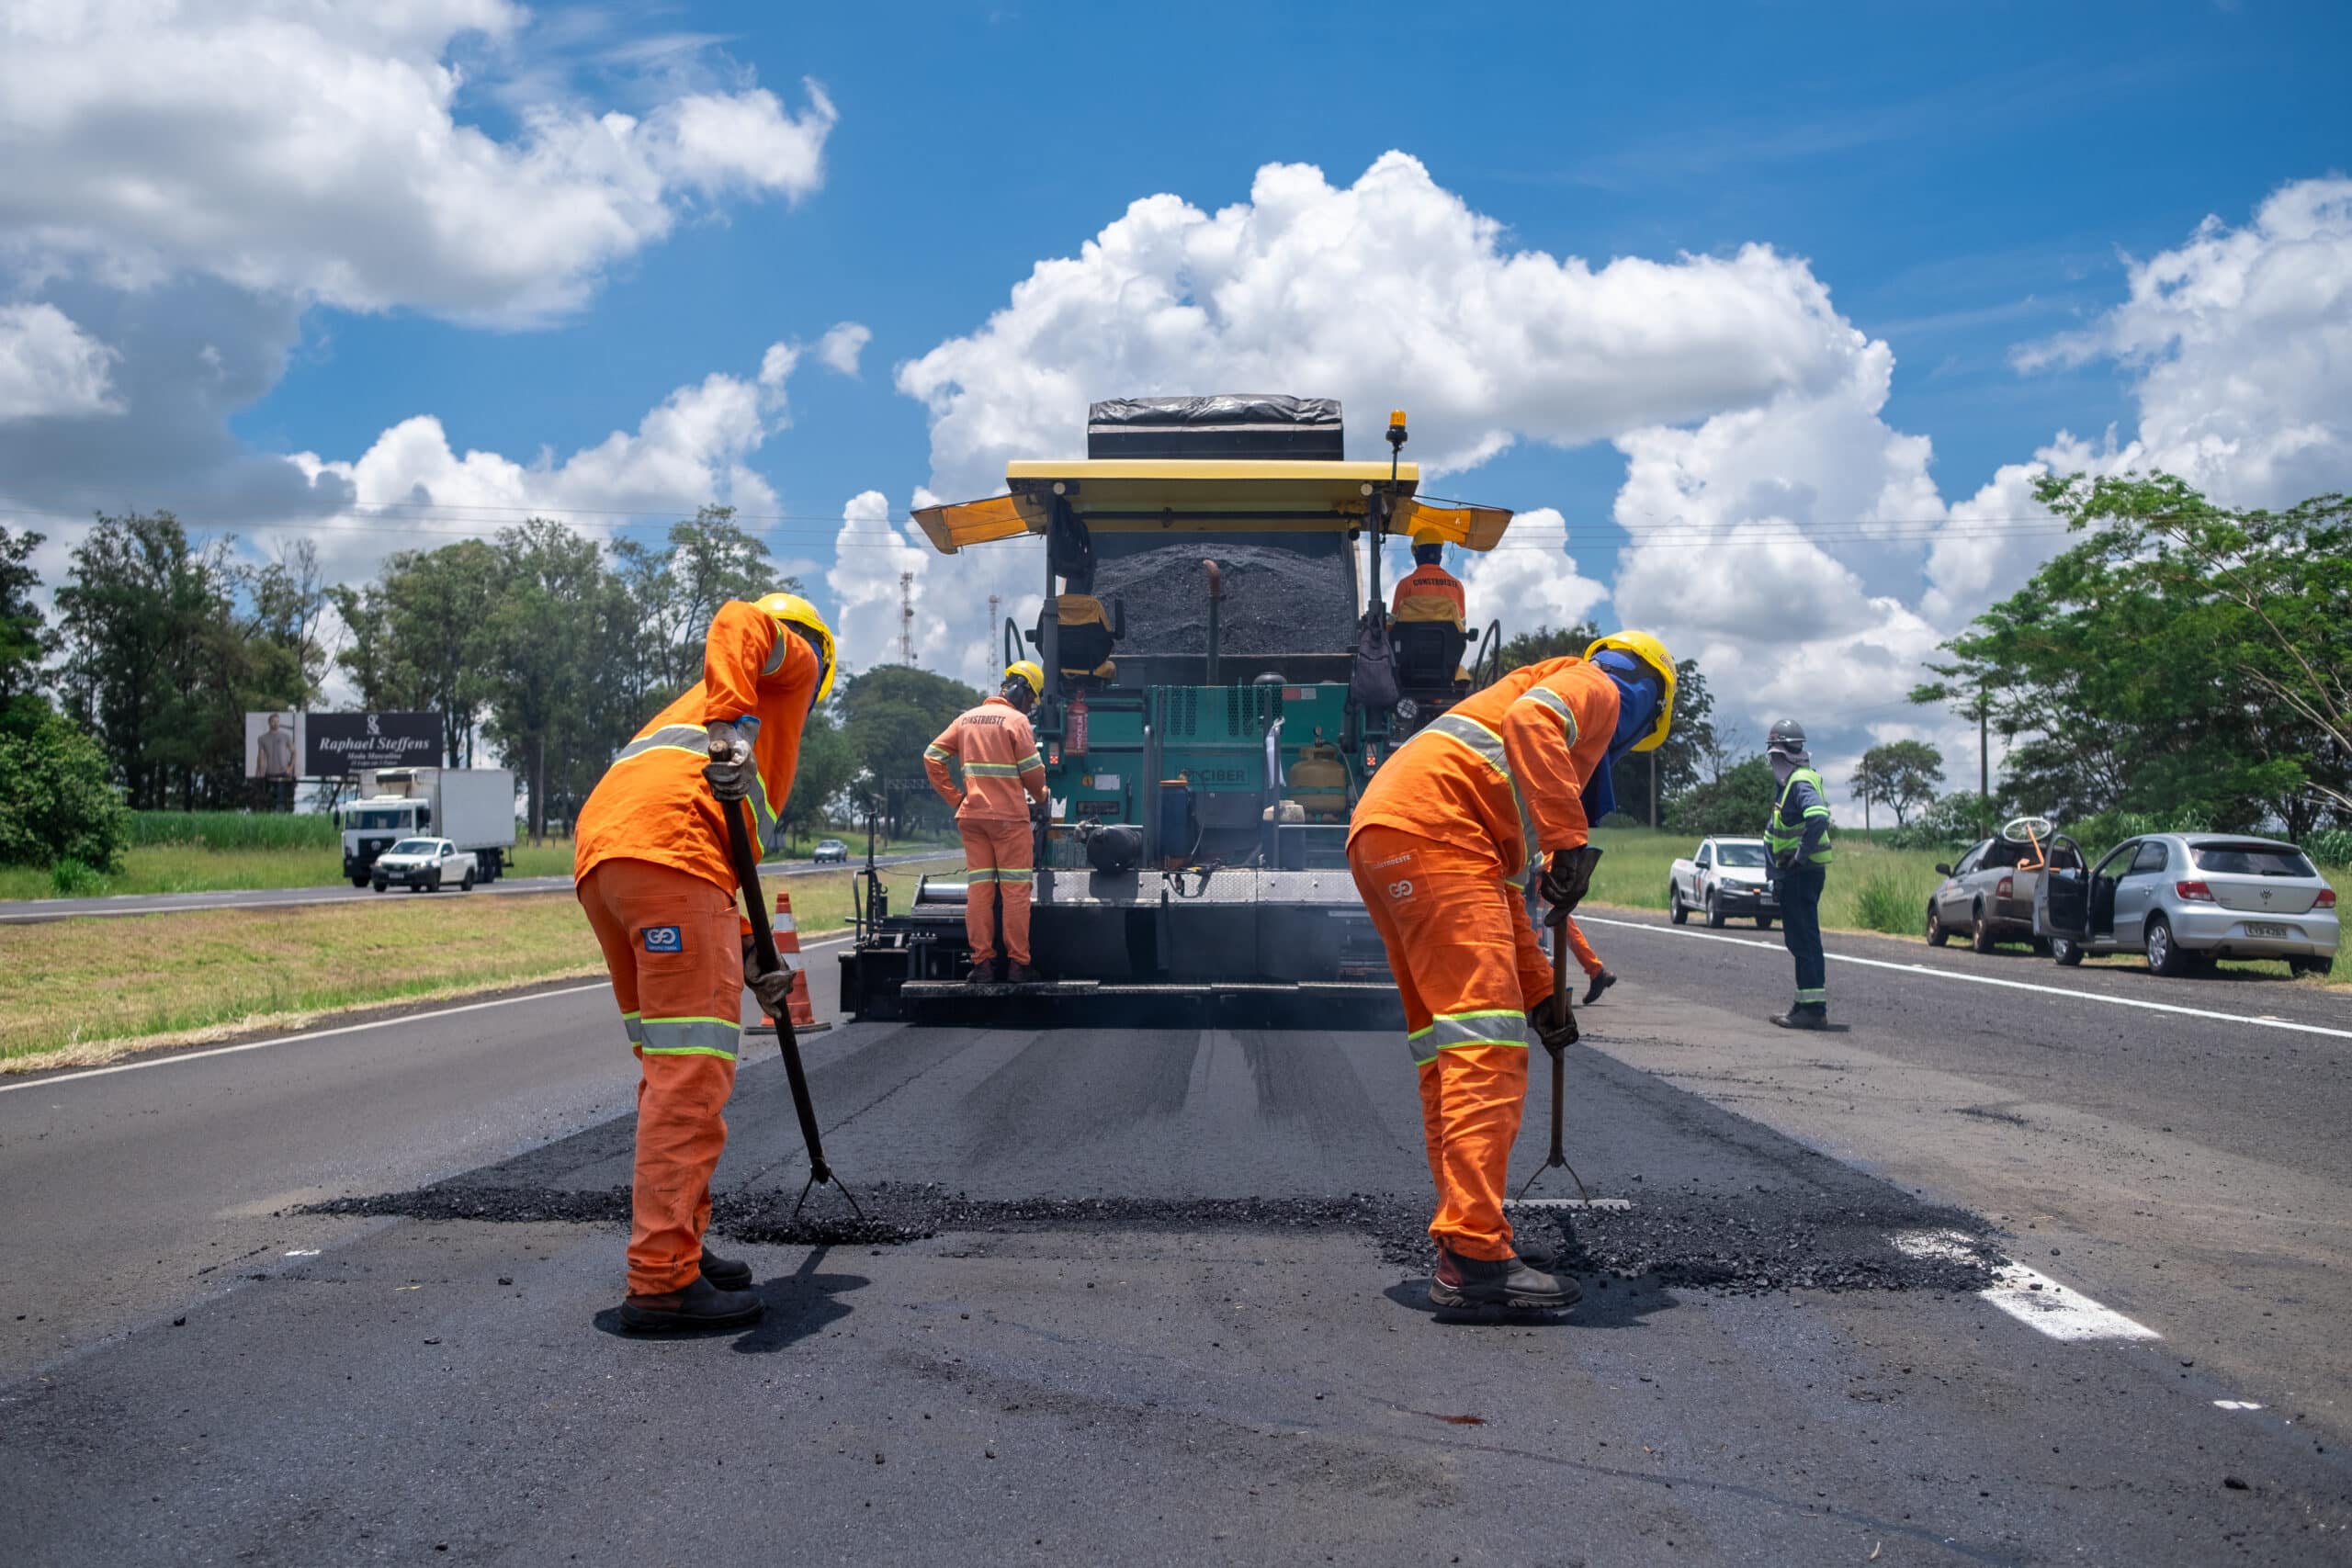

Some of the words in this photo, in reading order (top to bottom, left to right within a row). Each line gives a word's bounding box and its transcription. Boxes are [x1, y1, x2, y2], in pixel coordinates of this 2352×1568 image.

[319, 737, 374, 753] Raphael
[376, 736, 430, 752] Steffens
[1202, 770, 1247, 782] CIBER
